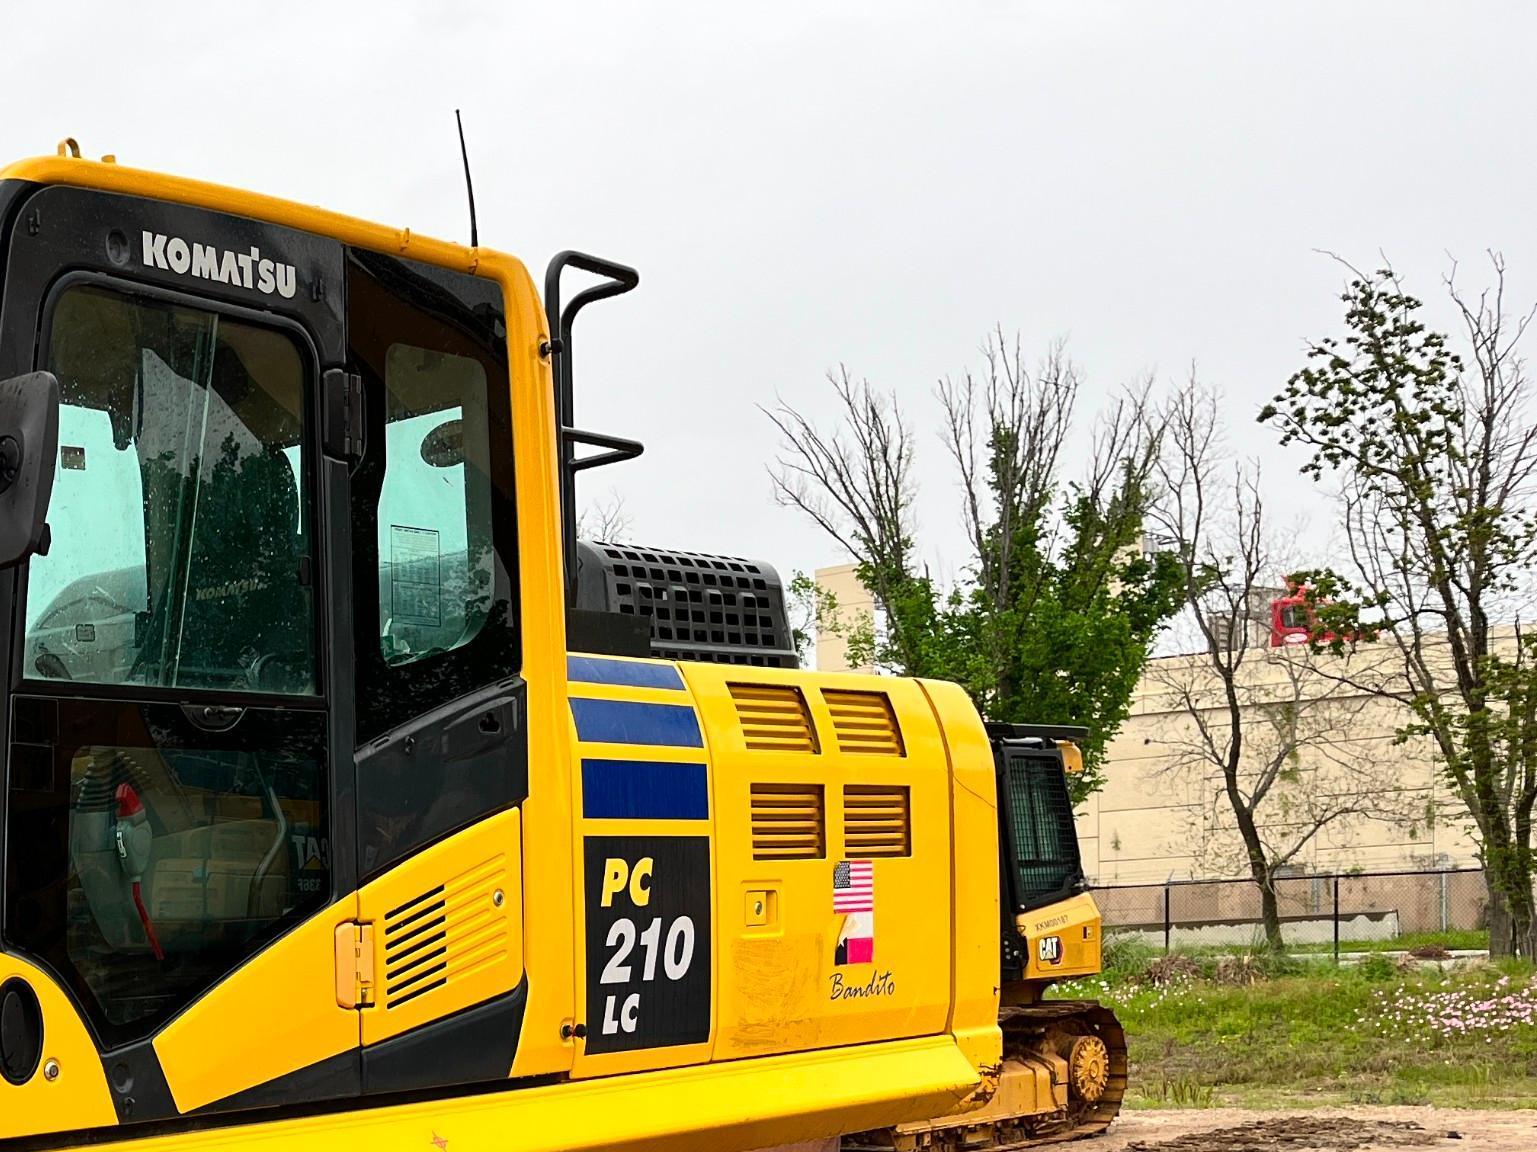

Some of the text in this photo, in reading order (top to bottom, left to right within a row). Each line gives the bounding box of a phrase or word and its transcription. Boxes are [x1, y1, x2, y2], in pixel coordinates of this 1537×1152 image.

[142, 230, 296, 299] KOMATSU
[600, 857, 654, 907] PC
[599, 915, 695, 985] 210
[1039, 937, 1058, 961] CAT
[829, 969, 896, 1001] Bandito
[602, 993, 641, 1035] LC
